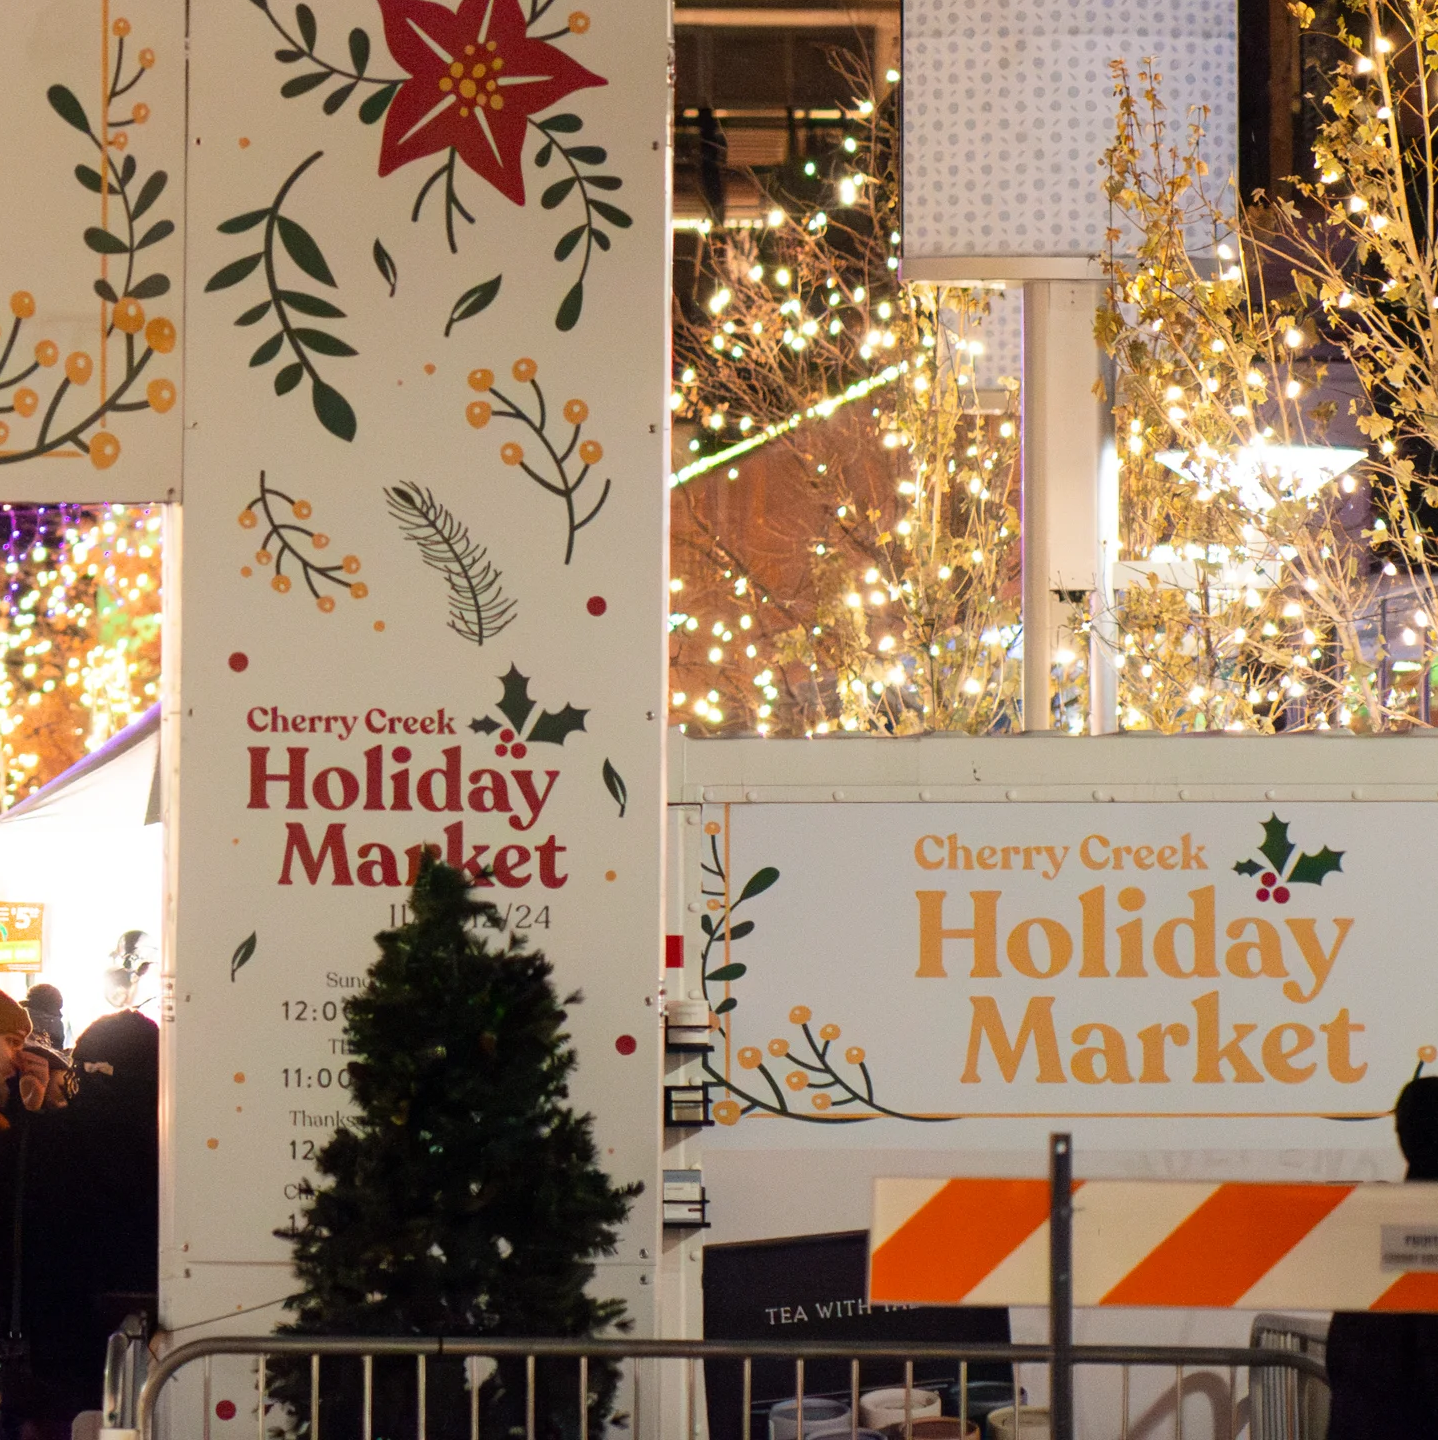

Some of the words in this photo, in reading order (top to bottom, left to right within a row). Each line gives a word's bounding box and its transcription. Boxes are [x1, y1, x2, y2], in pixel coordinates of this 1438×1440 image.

[246, 706, 359, 738] Cherry
[364, 708, 457, 735] Creek
[246, 744, 561, 831] Holiday
[913, 832, 1069, 880] Cherry
[1078, 833, 1209, 871] Creek
[914, 884, 1355, 1004] Holiday
[959, 990, 1368, 1085] Market
[765, 1306, 809, 1326] TEA
[815, 1298, 872, 1320] WITH
